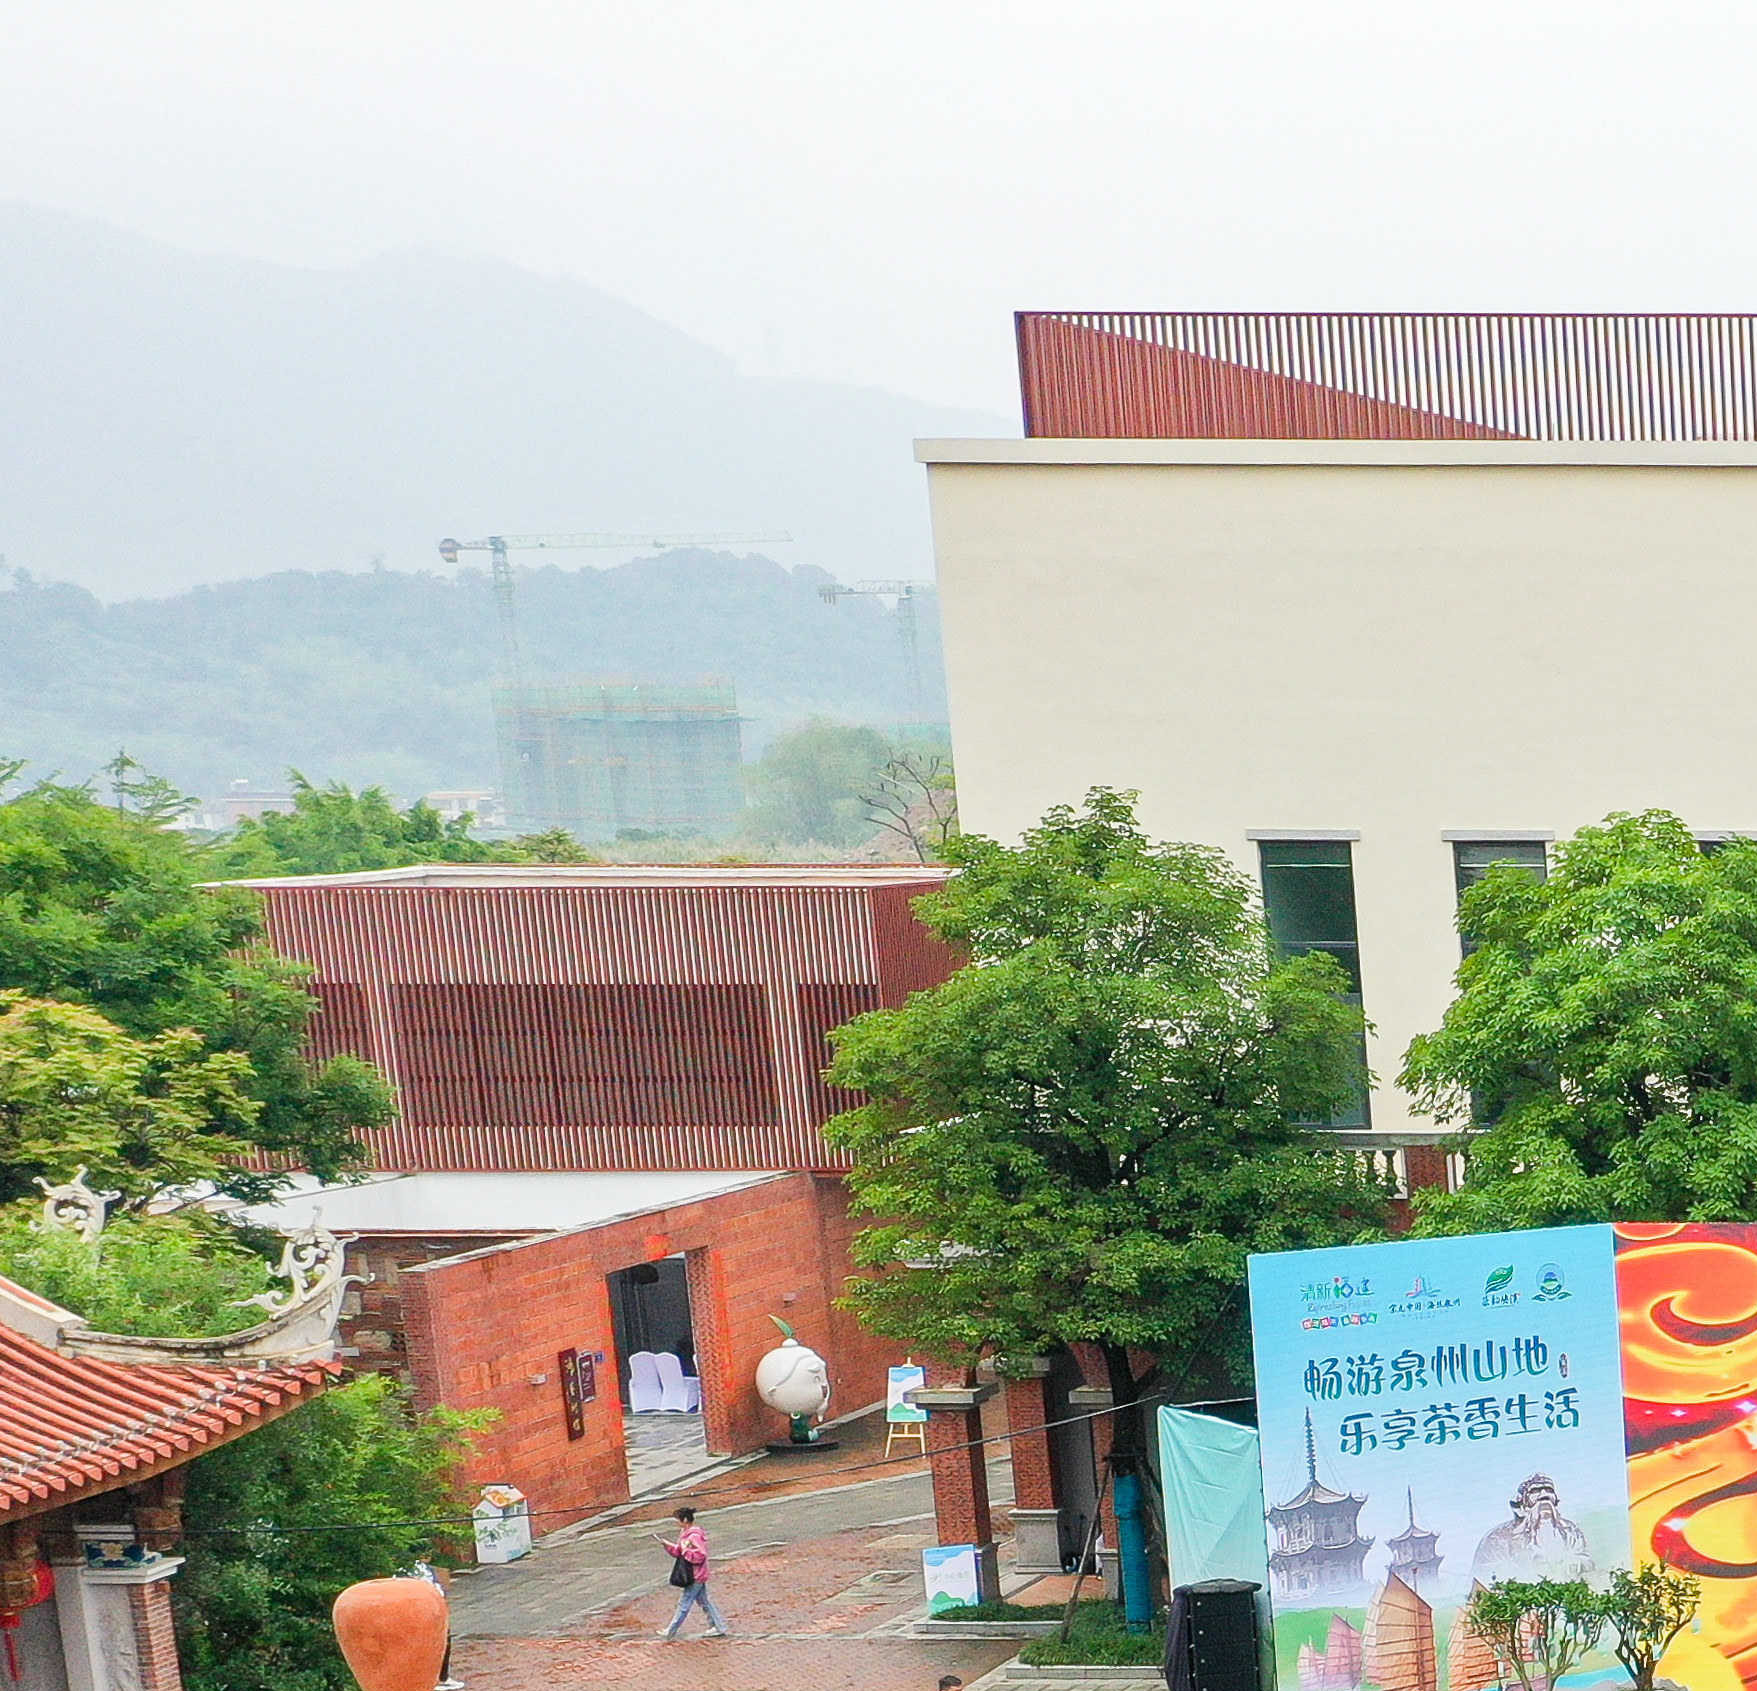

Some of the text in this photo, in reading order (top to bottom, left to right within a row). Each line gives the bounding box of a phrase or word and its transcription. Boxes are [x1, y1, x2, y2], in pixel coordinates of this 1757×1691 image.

[1304, 1335, 1549, 1400] 畅游泉州山地
[1340, 1387, 1580, 1456] 乐享茶香生活
